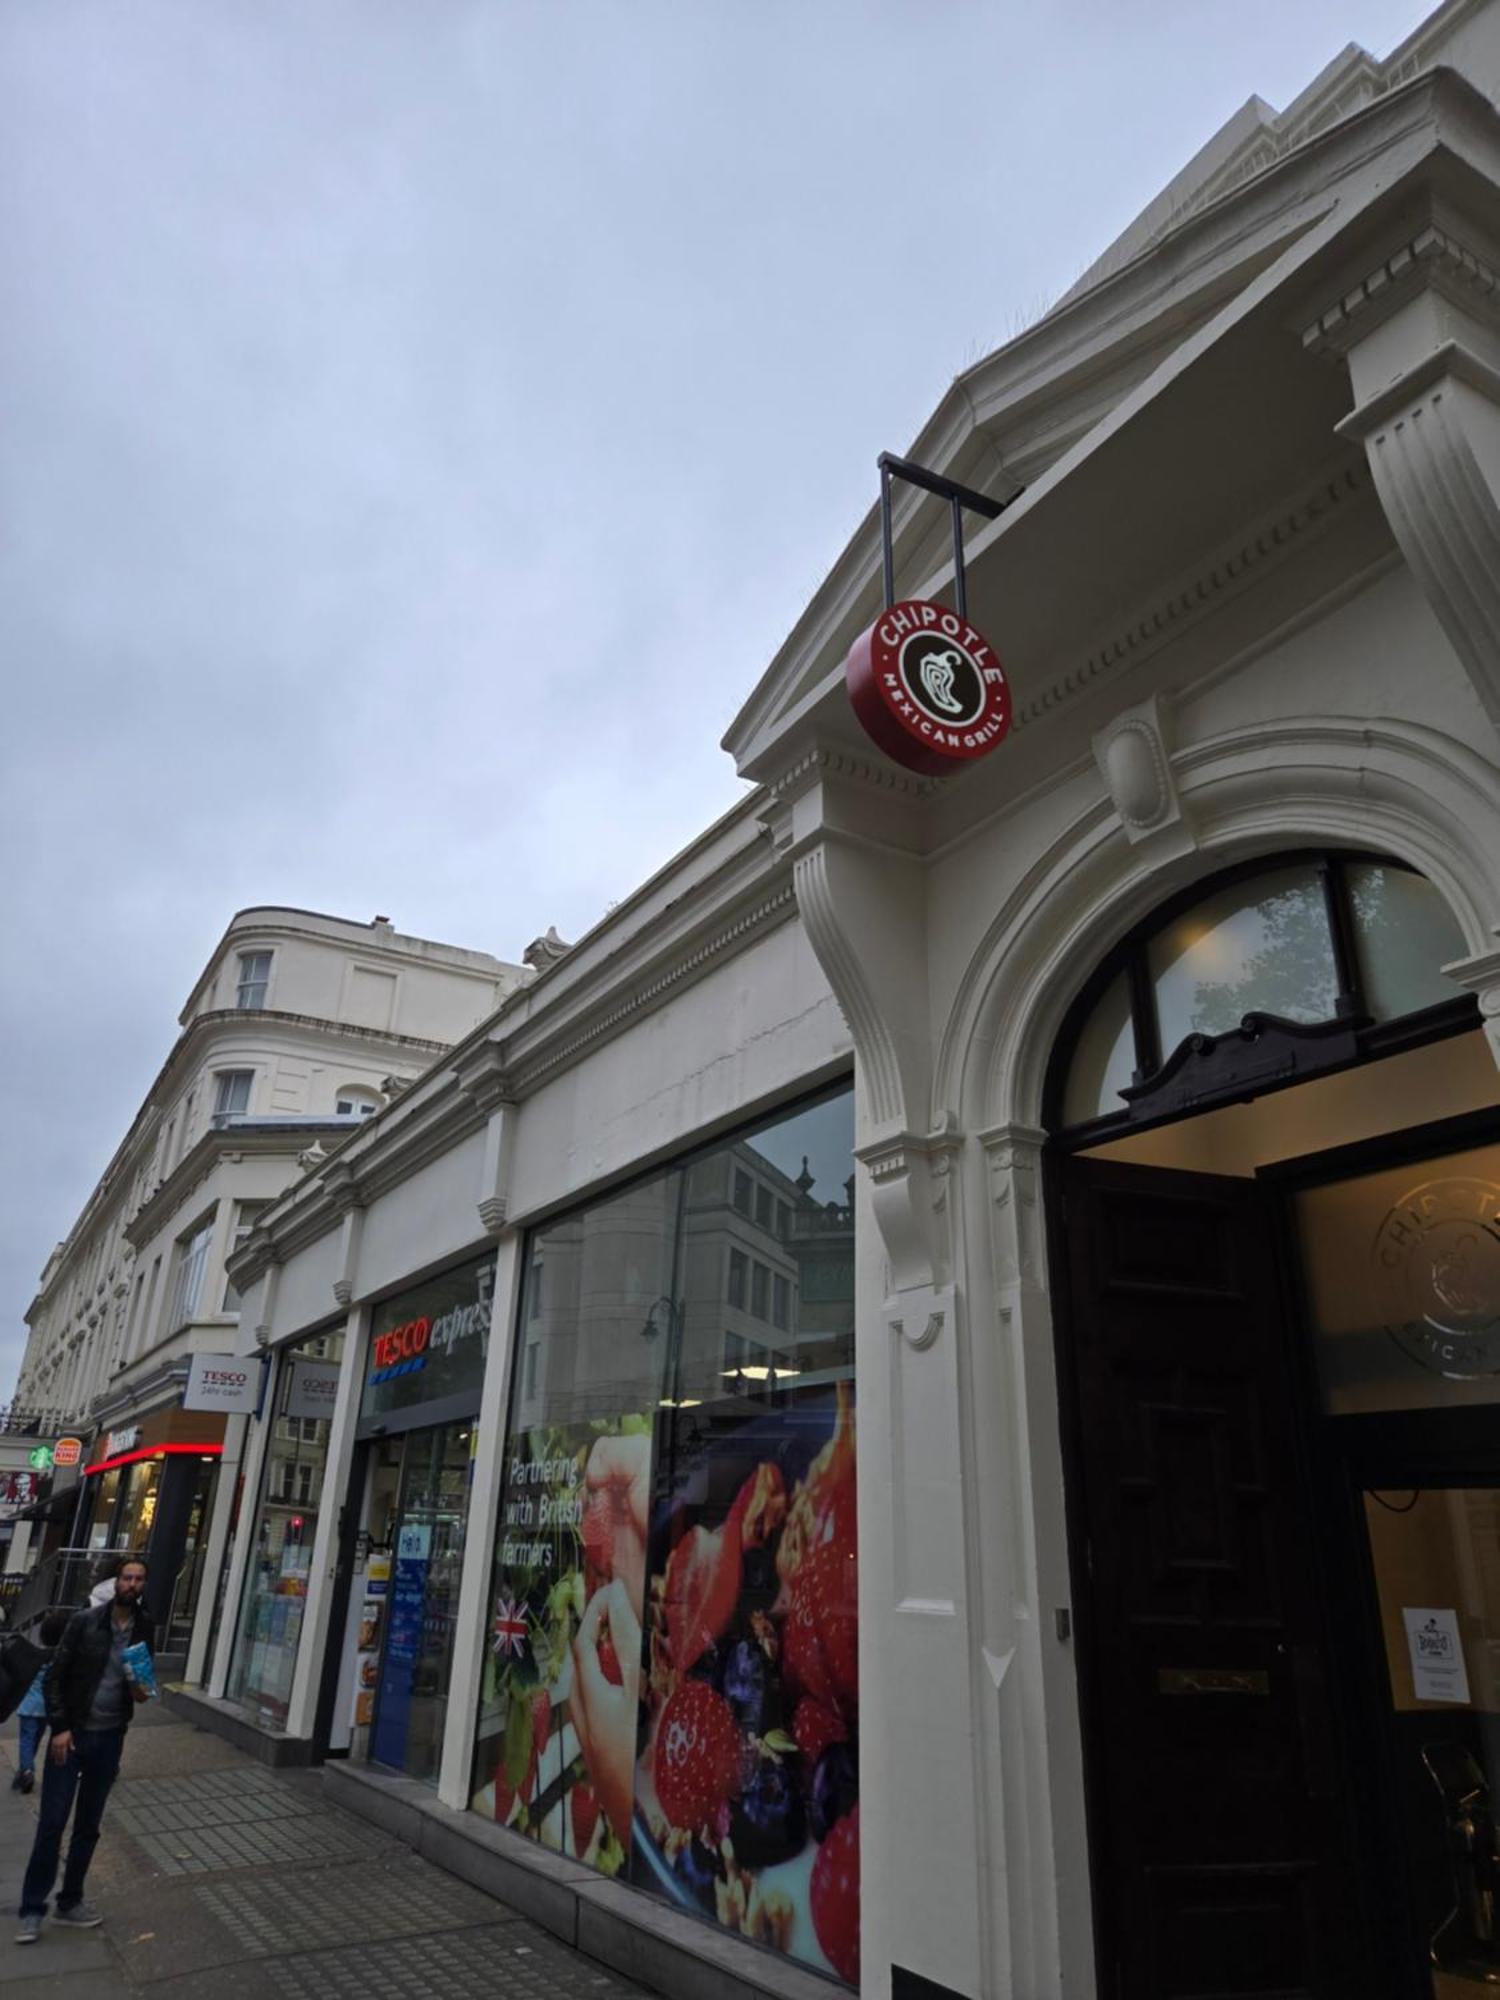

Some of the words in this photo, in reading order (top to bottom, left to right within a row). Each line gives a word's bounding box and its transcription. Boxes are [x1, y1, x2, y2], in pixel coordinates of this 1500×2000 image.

[880, 606, 1003, 684] CHIPOTLE
[884, 673, 960, 747] MEXICAN
[964, 713, 1003, 747] GRILL
[373, 1315, 429, 1368] TESCO
[429, 1300, 492, 1356] expres
[202, 1370, 247, 1382] TESCO
[510, 1457, 577, 1488] Partnering
[506, 1495, 533, 1525] with
[538, 1494, 583, 1525] British
[501, 1535, 553, 1568] farmers
